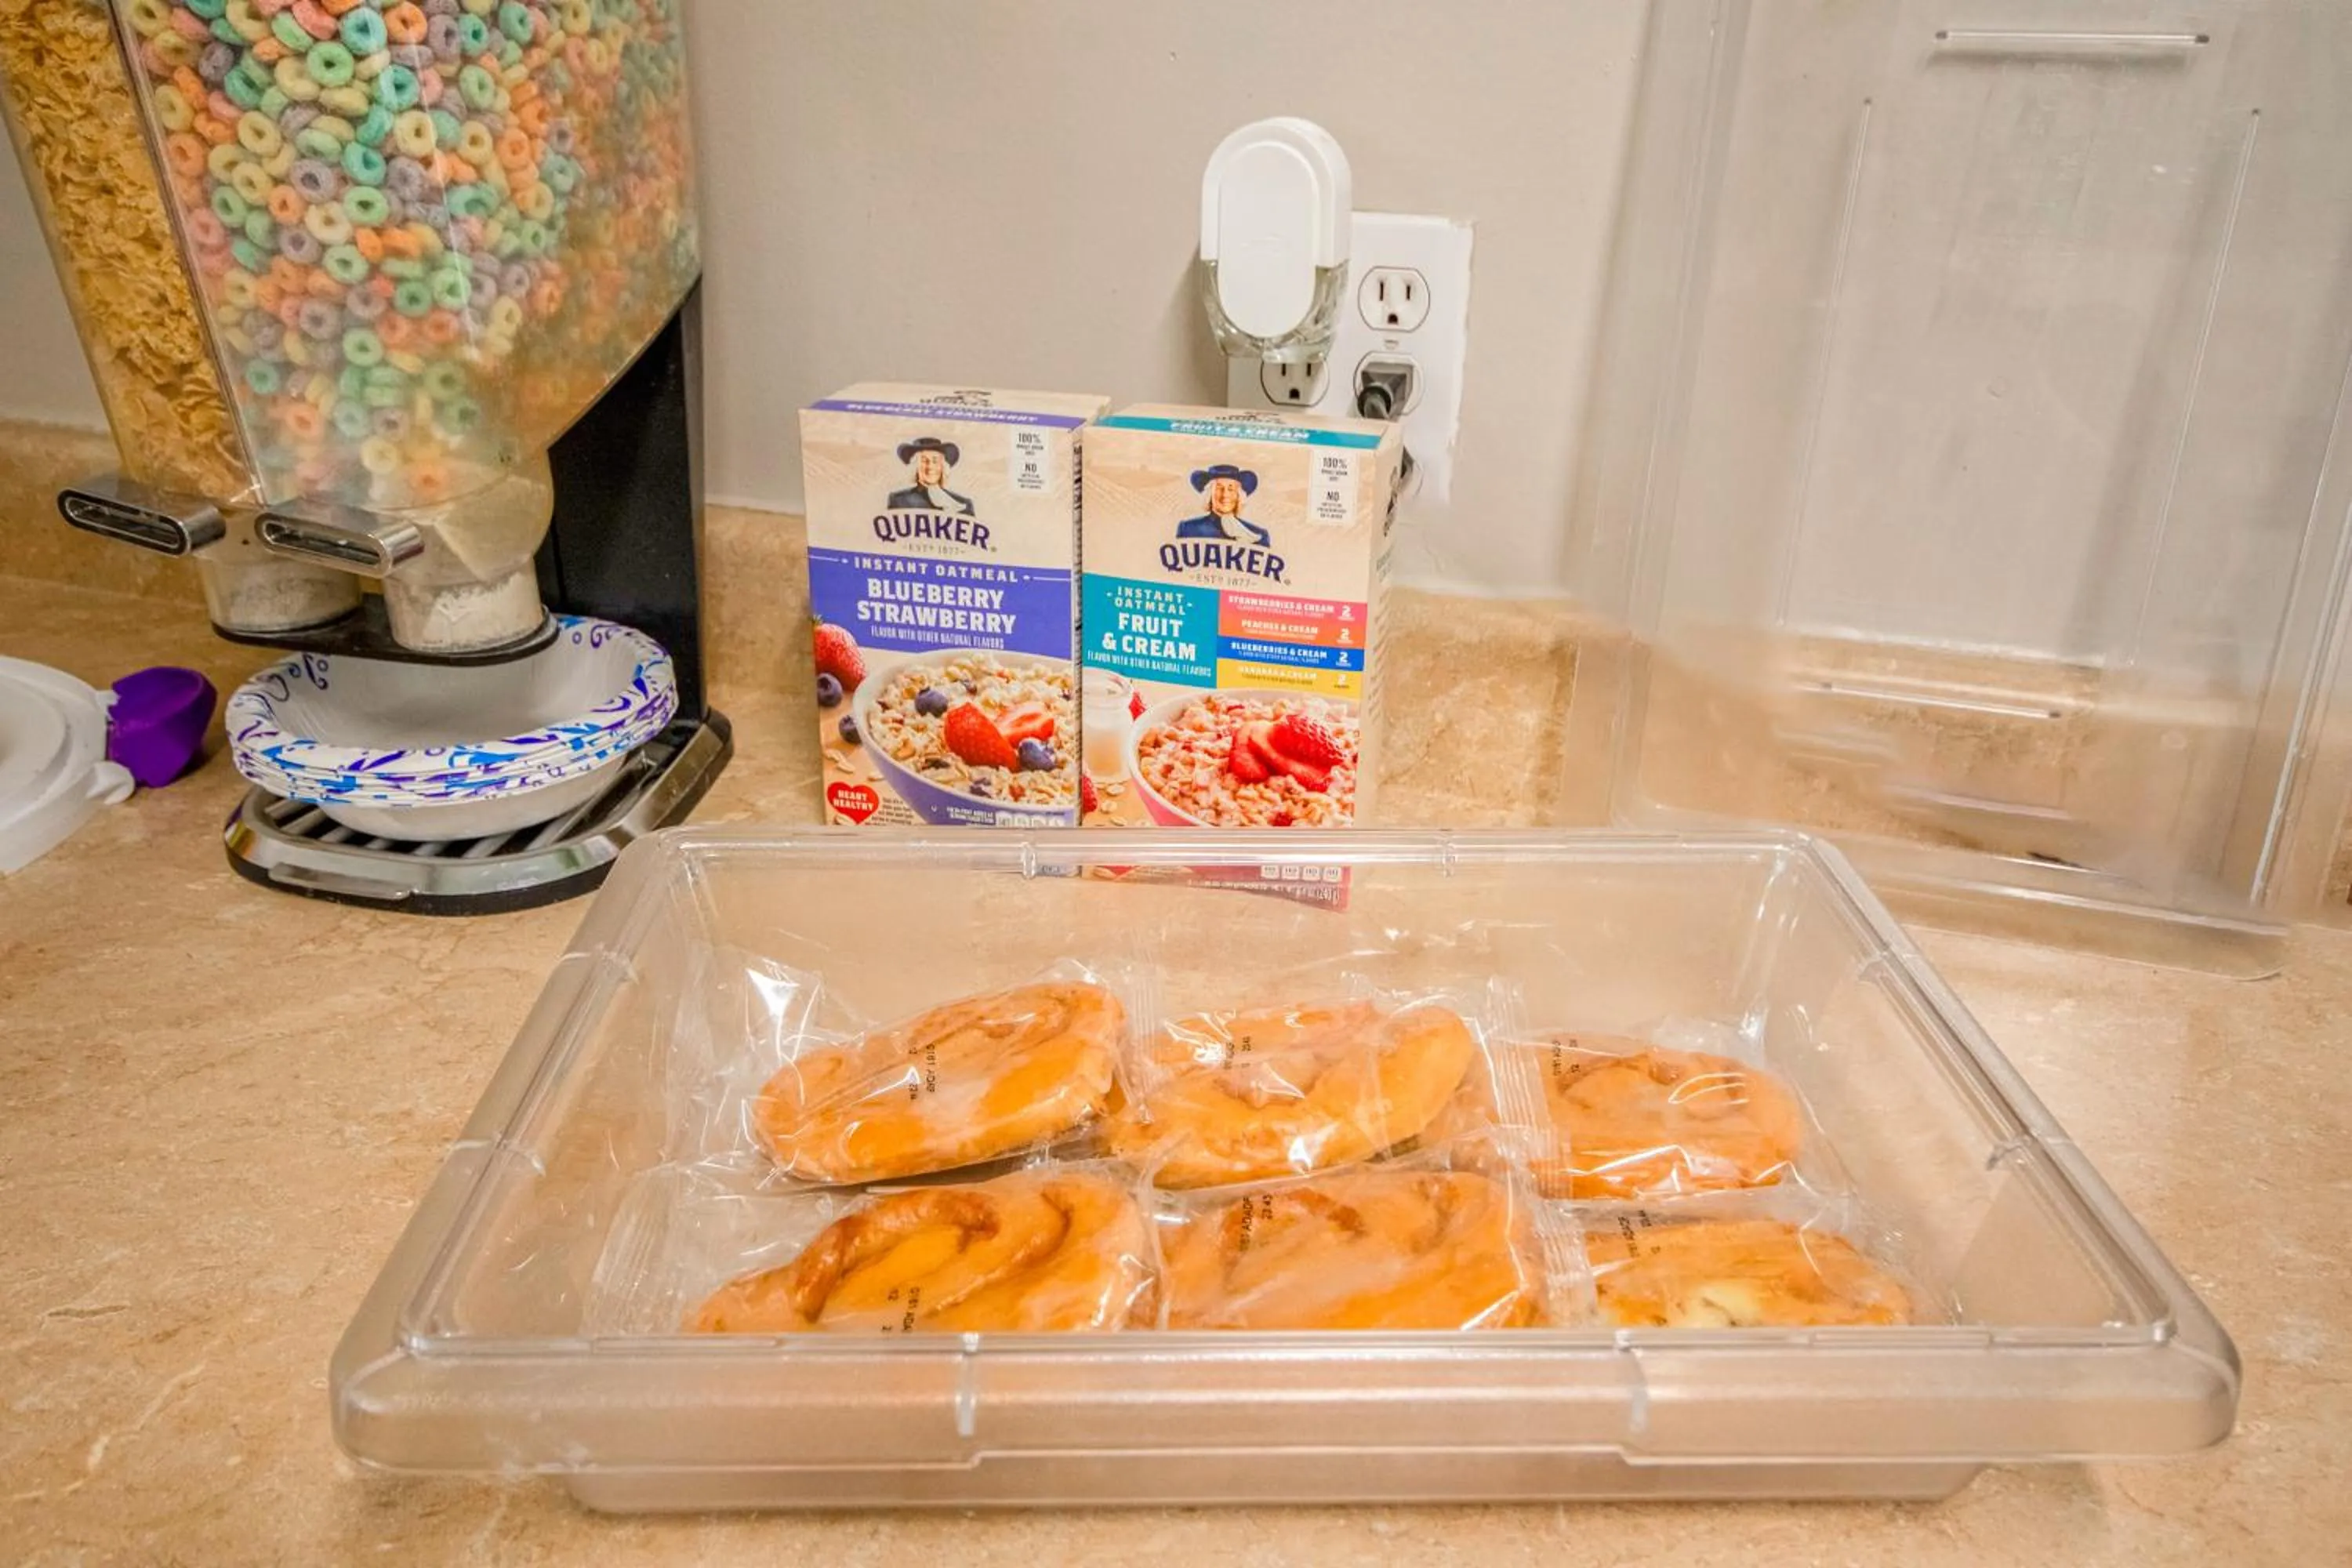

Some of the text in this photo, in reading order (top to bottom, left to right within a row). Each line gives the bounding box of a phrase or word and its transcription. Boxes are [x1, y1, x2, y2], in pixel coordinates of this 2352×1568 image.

[1025, 463, 1037, 473] NO
[1327, 492, 1340, 502] NO
[873, 514, 990, 550] QUAKER
[853, 556, 1018, 583] INSTANT OATMEAL
[1160, 543, 1285, 583] QUAKER
[867, 578, 1004, 609] BLUEBERRY
[1116, 586, 1186, 604] INSTANT
[1114, 598, 1186, 616] OATMEAL
[1229, 595, 1295, 609] STRAWBERRIES
[1304, 603, 1334, 613] CREAM
[1341, 604, 1352, 618] 2
[856, 601, 1017, 635] STRAWBERRY
[1118, 612, 1184, 638] FRUIT
[871, 625, 1004, 649] FLAVOR WITH OTHER NATURAL FLAVORS
[1288, 624, 1319, 634] CREAM
[1341, 627, 1350, 641] 2
[1102, 632, 1196, 662] & CREAM
[1230, 641, 1288, 655] BLUEBERRIES
[1298, 648, 1327, 659] CREAM
[1087, 650, 1211, 677] FLAVOR WITH OTHER NATURAL FLAVORS
[1339, 651, 1348, 663] 2
[837, 789, 867, 801] HEART
[833, 798, 874, 811] HEALTHY
